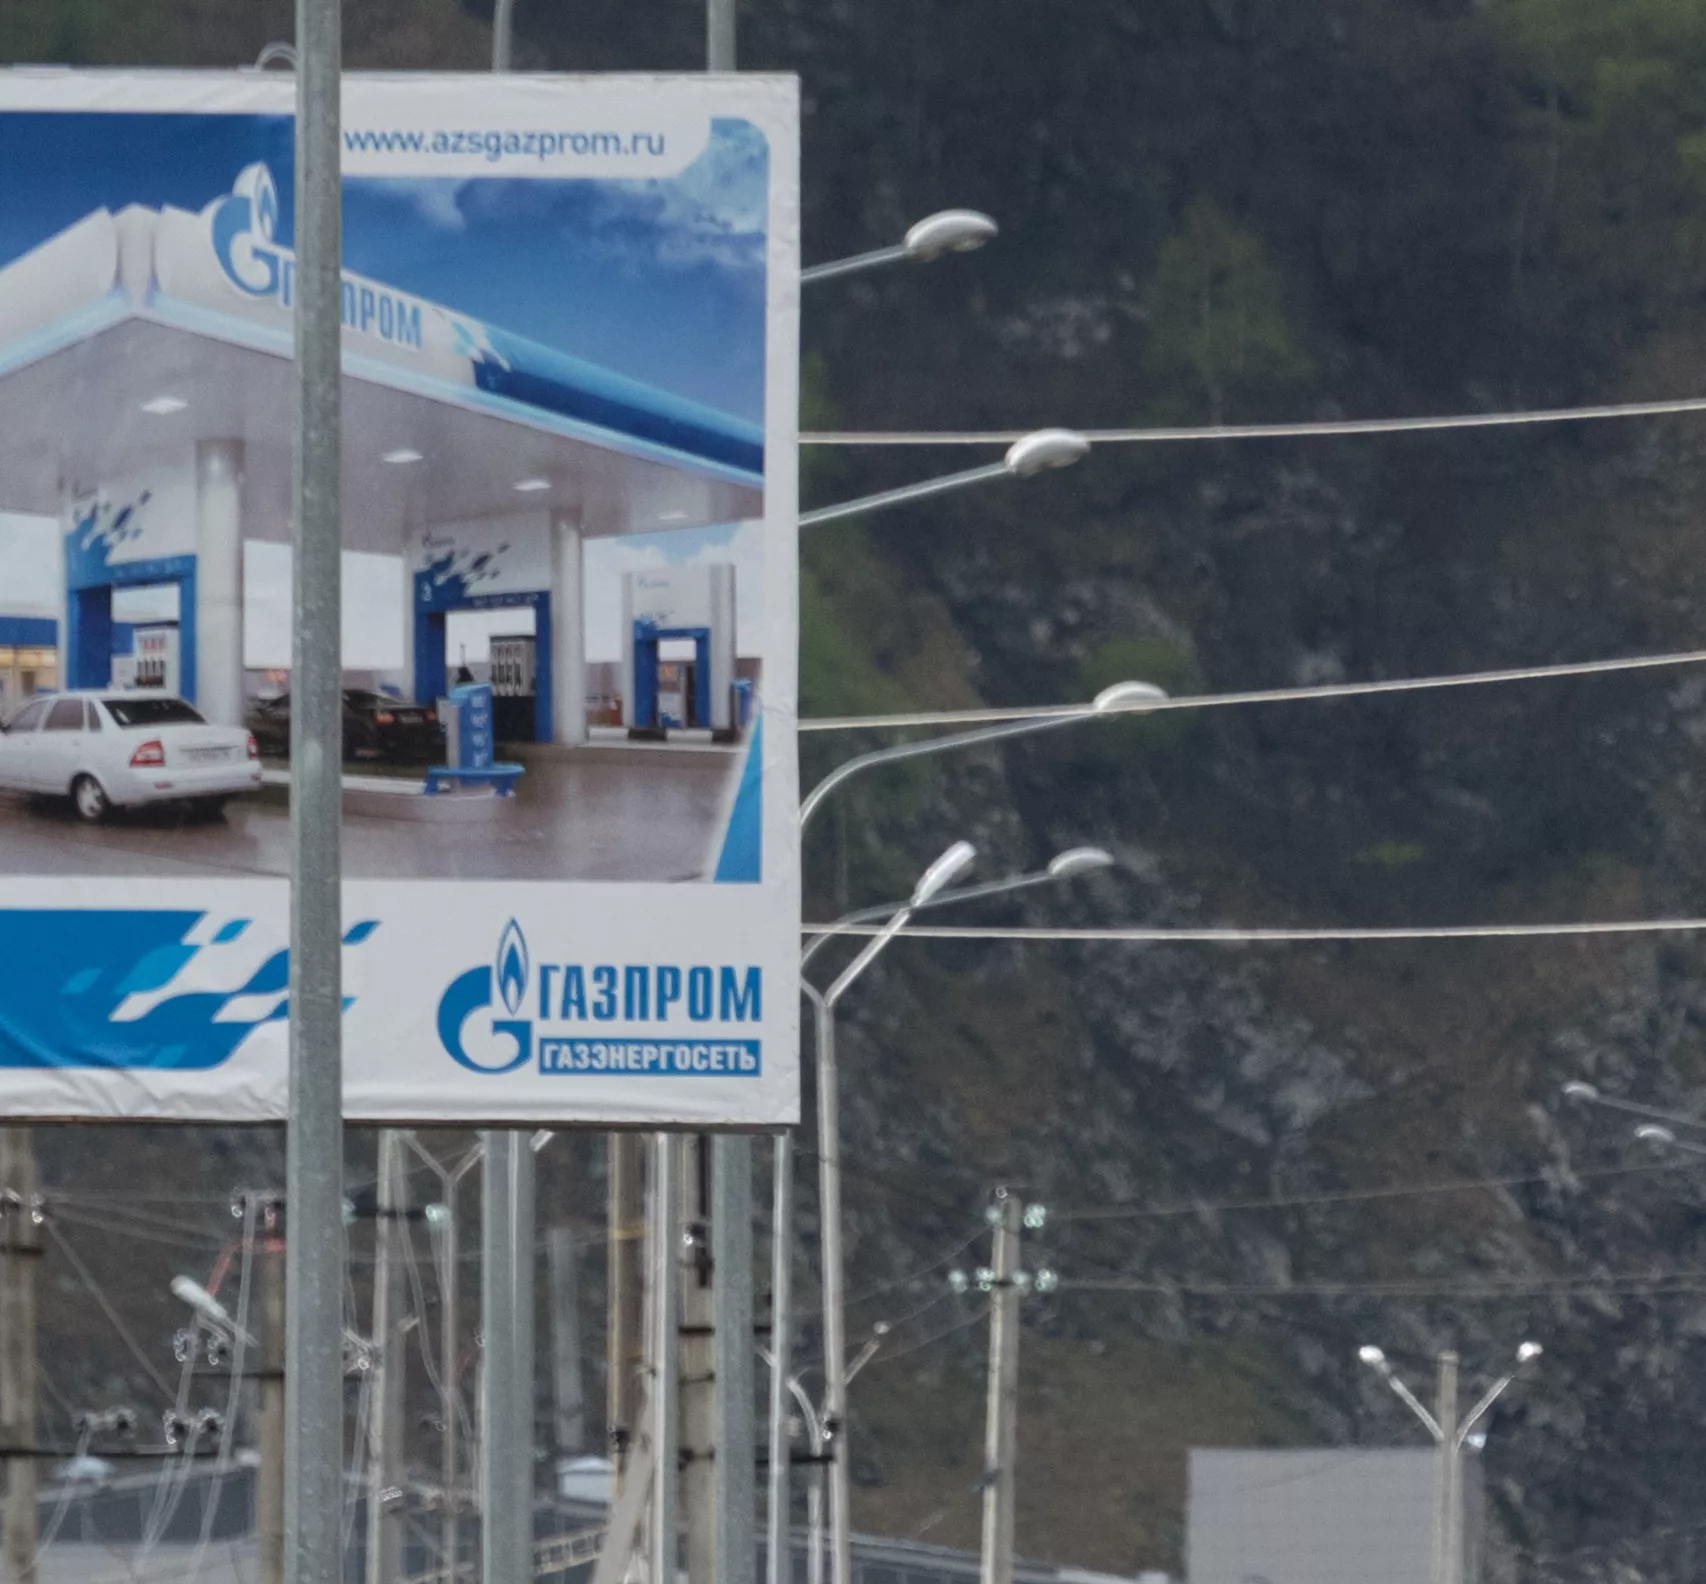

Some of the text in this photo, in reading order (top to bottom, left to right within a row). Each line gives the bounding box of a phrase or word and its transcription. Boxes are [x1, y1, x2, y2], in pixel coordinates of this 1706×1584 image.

[343, 129, 666, 162] www.azsgazprom.ru
[283, 258, 423, 349] ГПРОМ
[537, 964, 762, 1021] ГАЗПРОМ
[543, 1043, 757, 1071] ГАЗЭНЕРГОСЕТЬ
